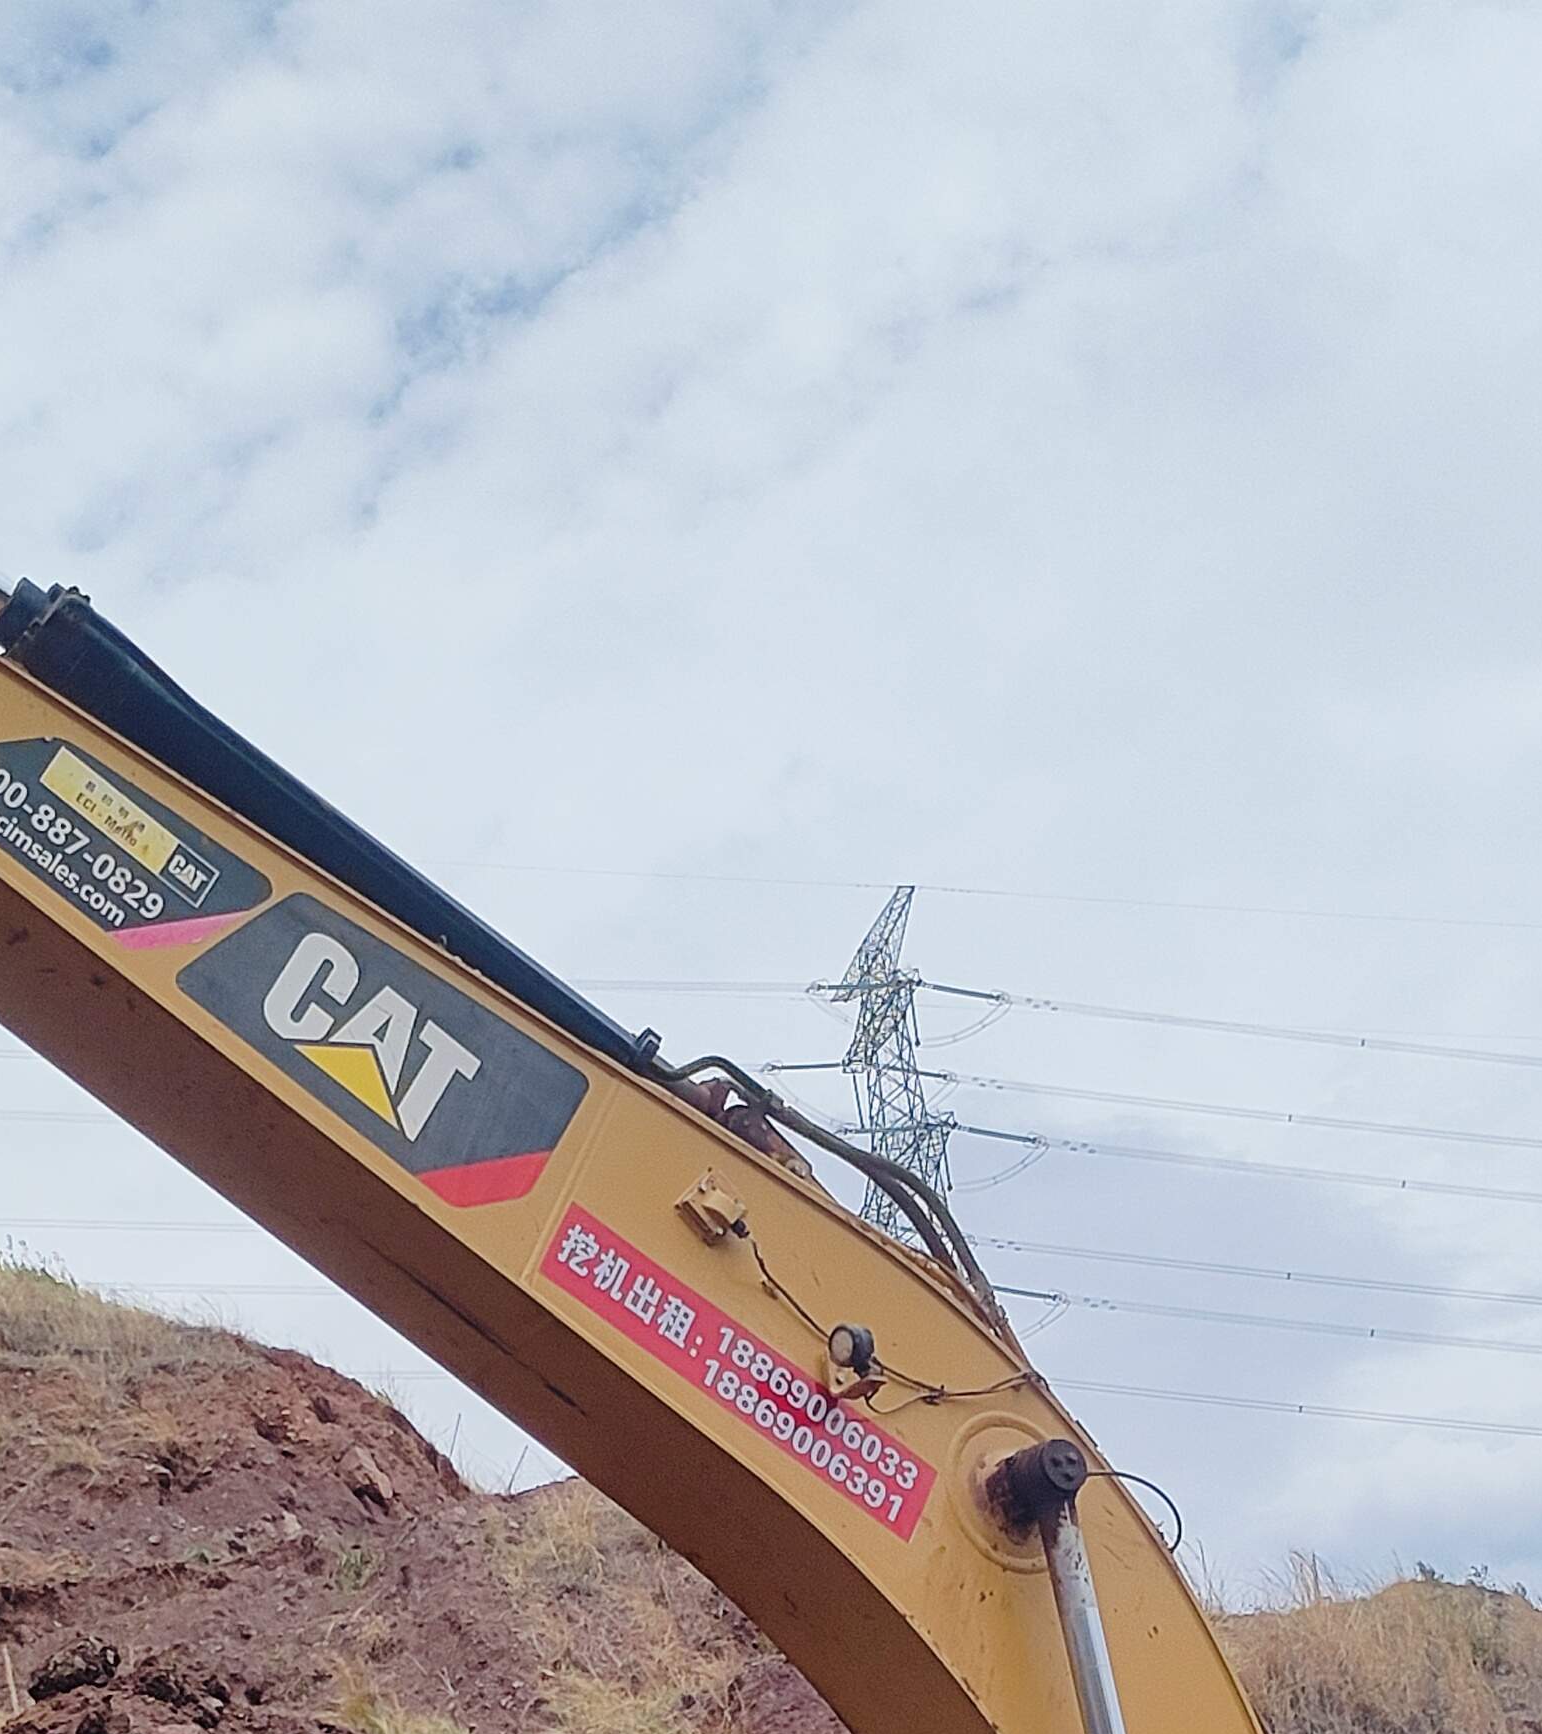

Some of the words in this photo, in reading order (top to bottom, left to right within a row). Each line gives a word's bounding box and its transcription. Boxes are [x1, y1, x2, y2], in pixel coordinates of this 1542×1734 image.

[168, 854, 209, 892] CAT
[263, 932, 483, 1142] CAT
[702, 1358, 904, 1523] 18869006391
[717, 1327, 919, 1490] 18869006033
